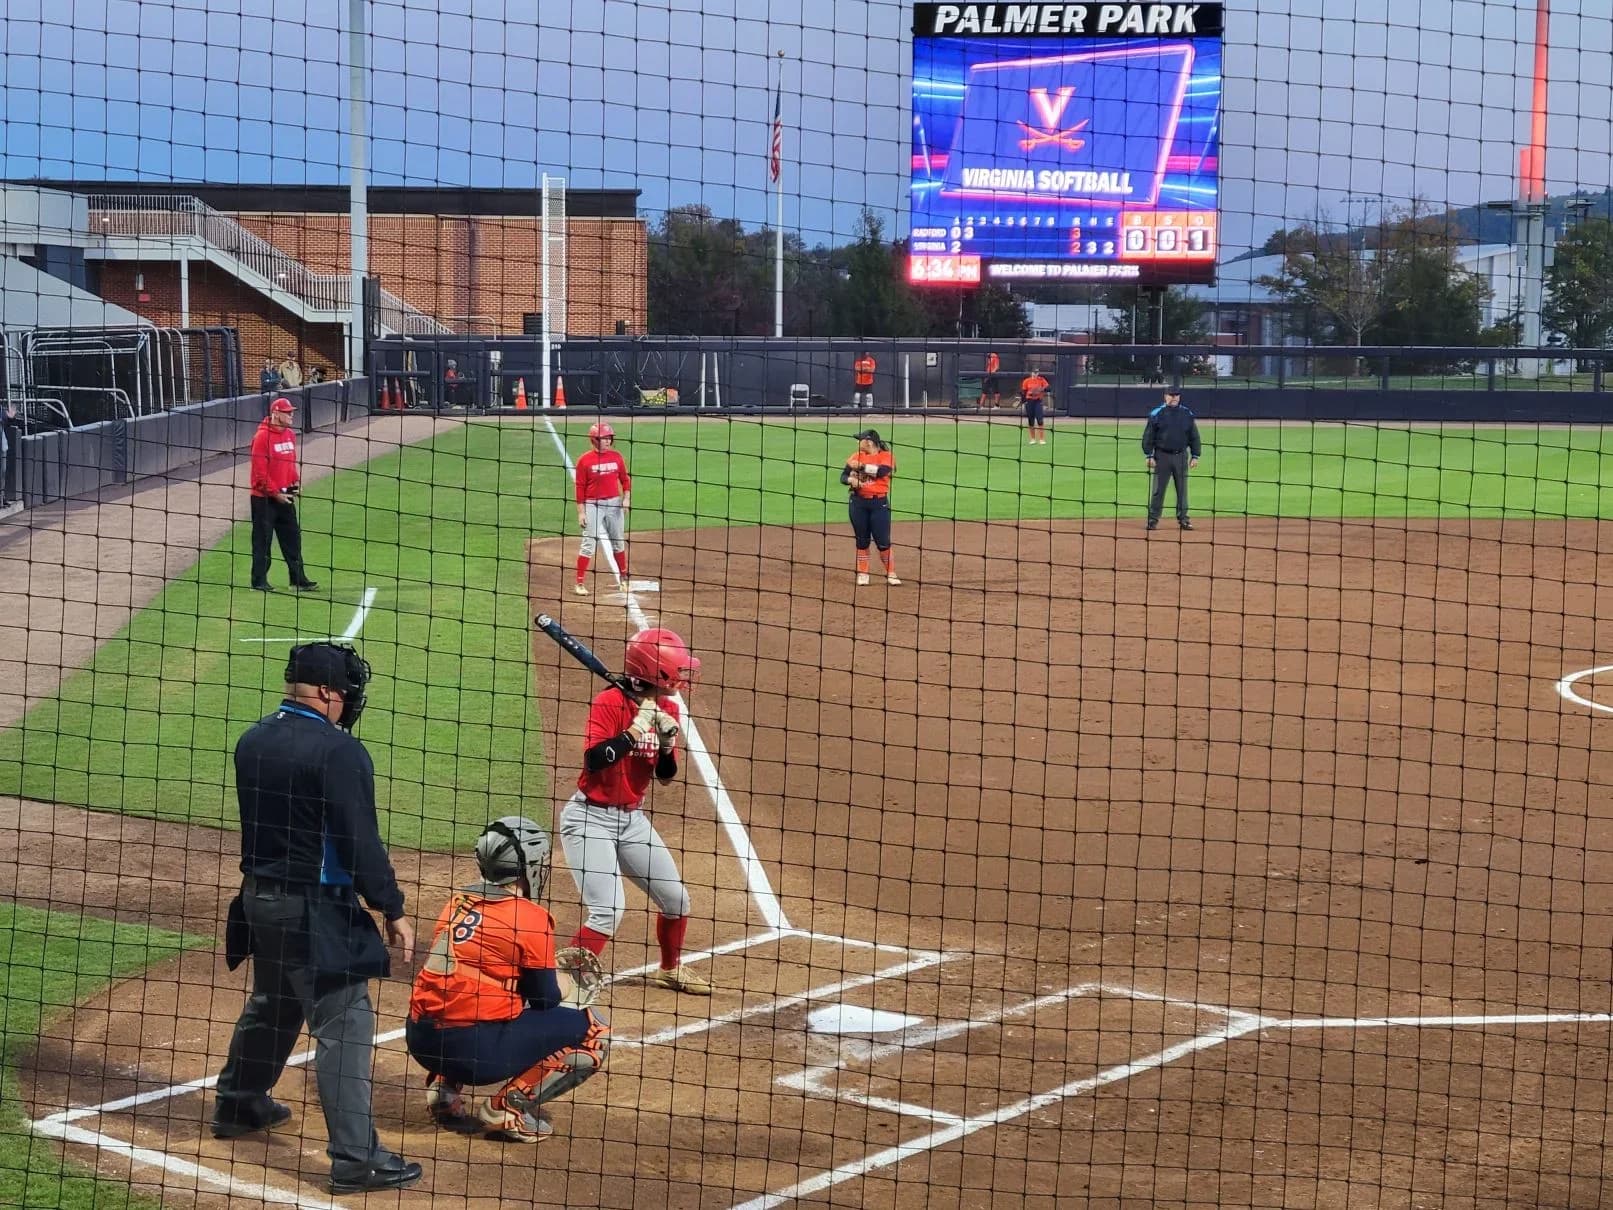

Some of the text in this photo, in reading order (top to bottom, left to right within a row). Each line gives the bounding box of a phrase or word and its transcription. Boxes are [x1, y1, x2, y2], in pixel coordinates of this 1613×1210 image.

[934, 5, 1200, 33] PALMER PARK
[962, 168, 1133, 194] VIRGINIA SOFTBALL
[951, 227, 961, 239] 0
[964, 227, 974, 240] 3
[1127, 229, 1144, 250] 0
[1158, 229, 1175, 250] 0
[1190, 229, 1204, 250] 1
[951, 241, 961, 253] 2
[1072, 241, 1081, 253] 2
[1086, 241, 1097, 254] 3
[1103, 241, 1114, 254] 2
[989, 264, 1046, 276] WELCOME
[1047, 264, 1061, 276] TO
[1061, 265, 1107, 277] PALMER
